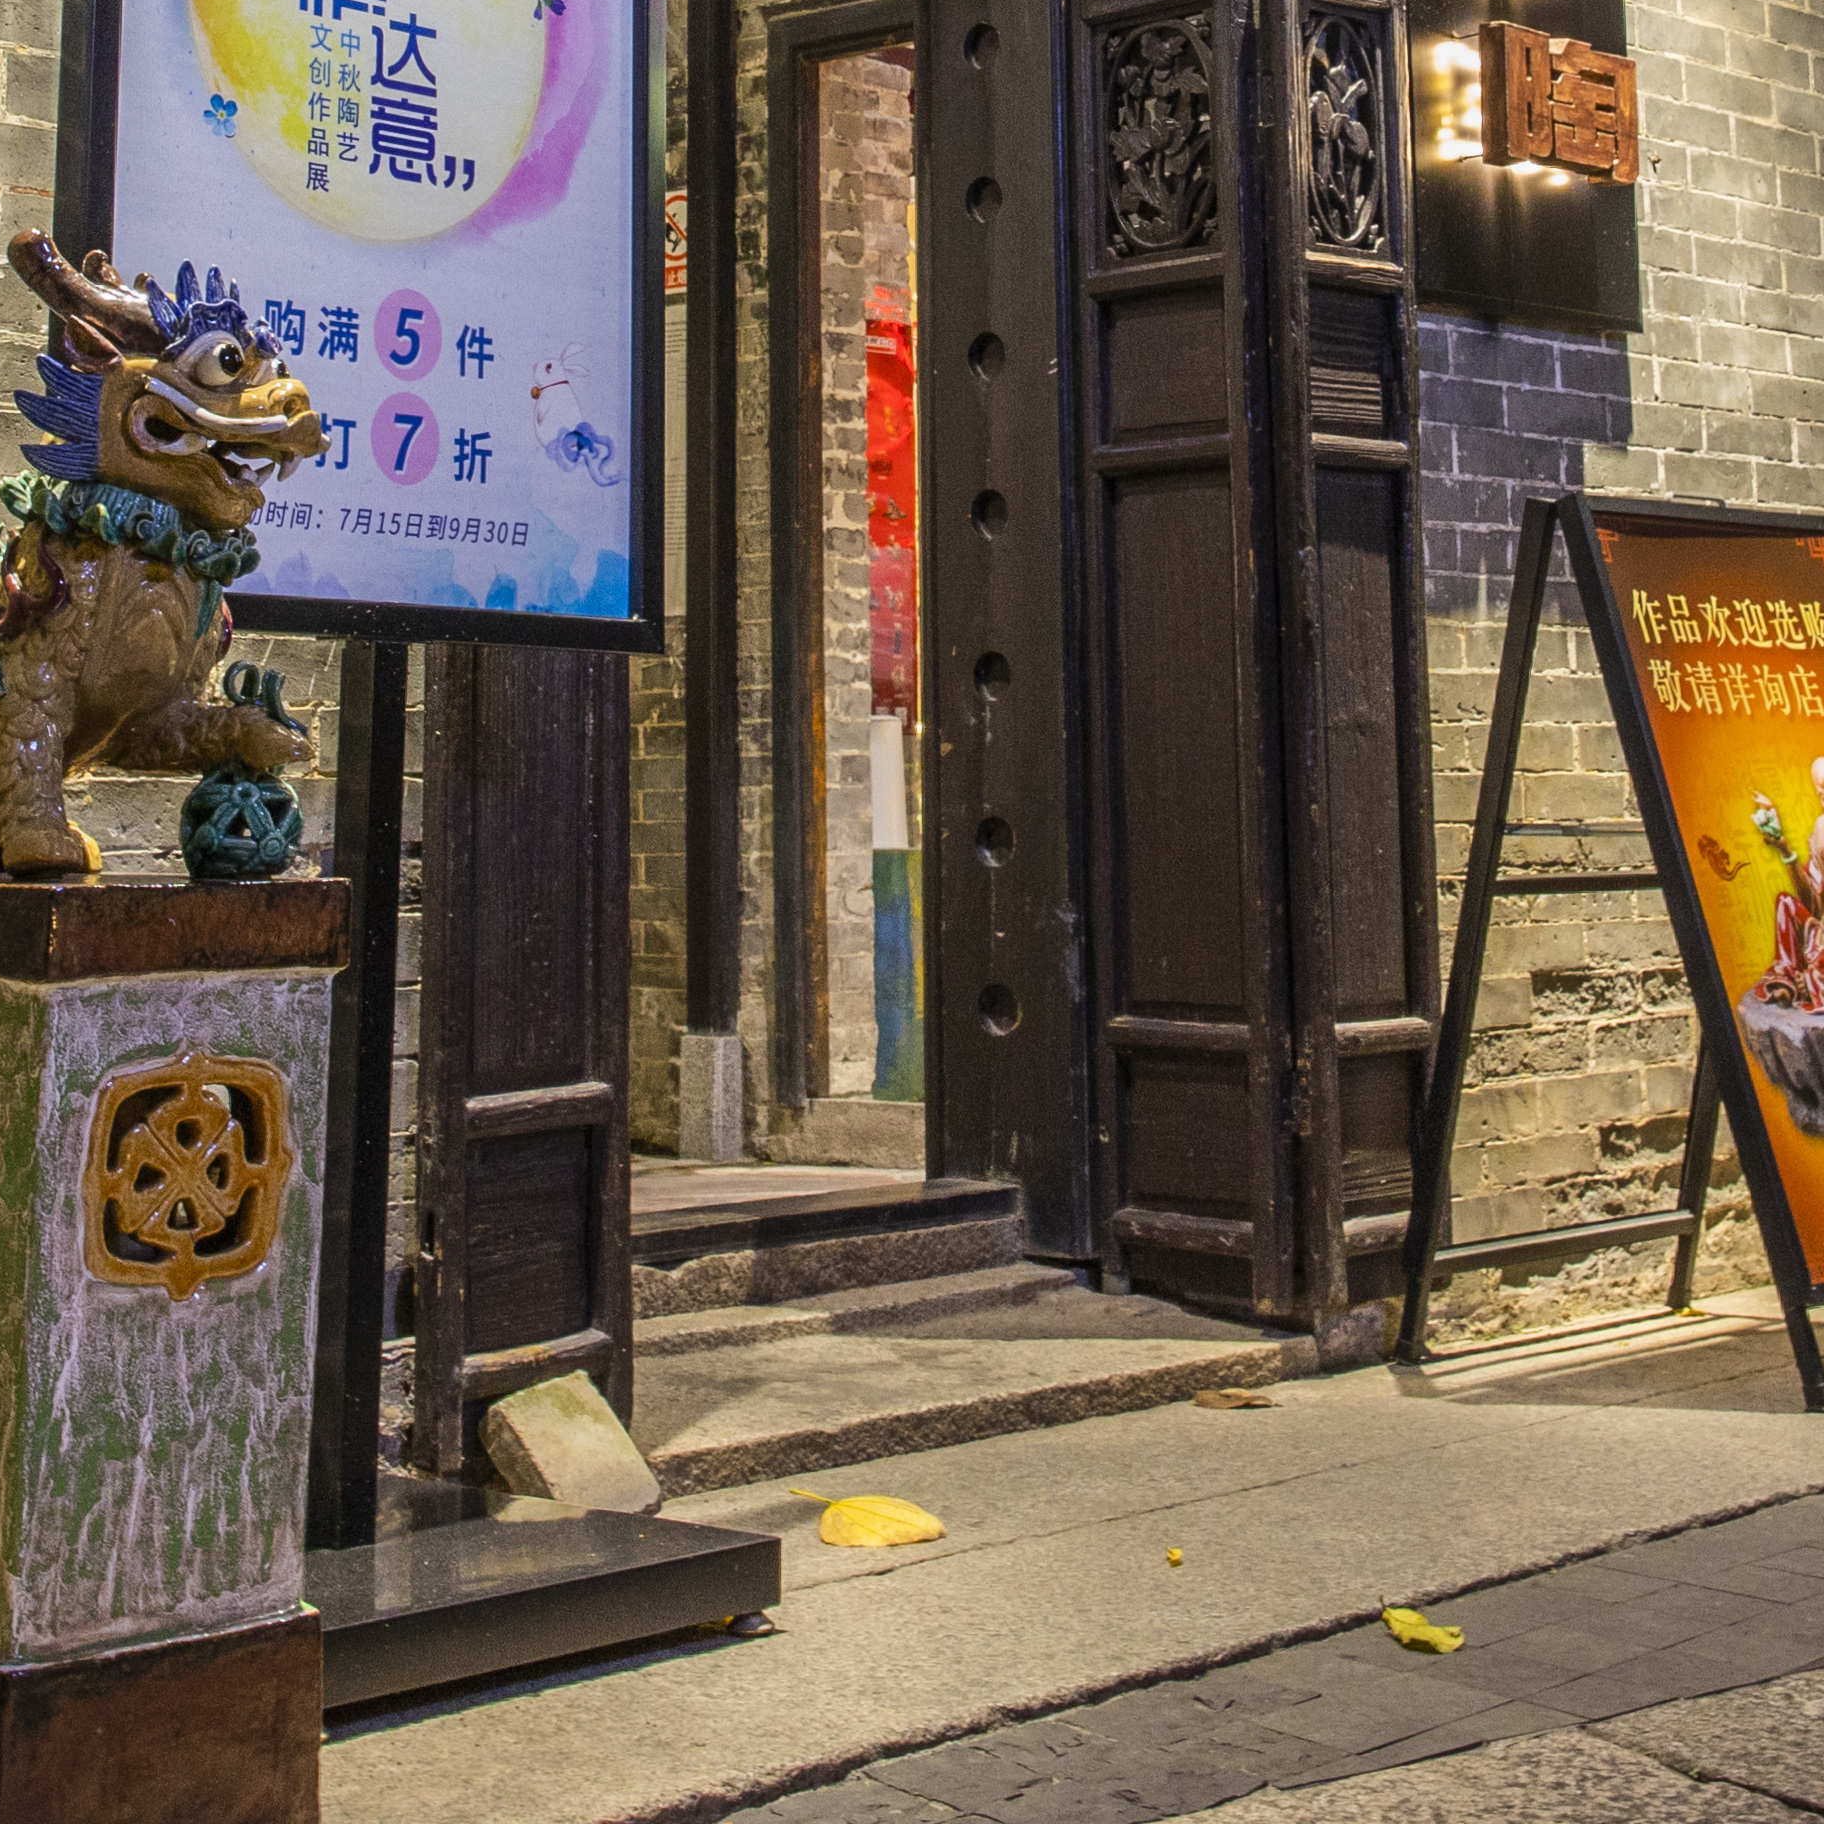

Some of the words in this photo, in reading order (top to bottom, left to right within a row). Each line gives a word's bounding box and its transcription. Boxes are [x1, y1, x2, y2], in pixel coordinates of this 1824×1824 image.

[306, 23, 333, 192] 文创作品展
[336, 28, 362, 163] 中秋陶艺
